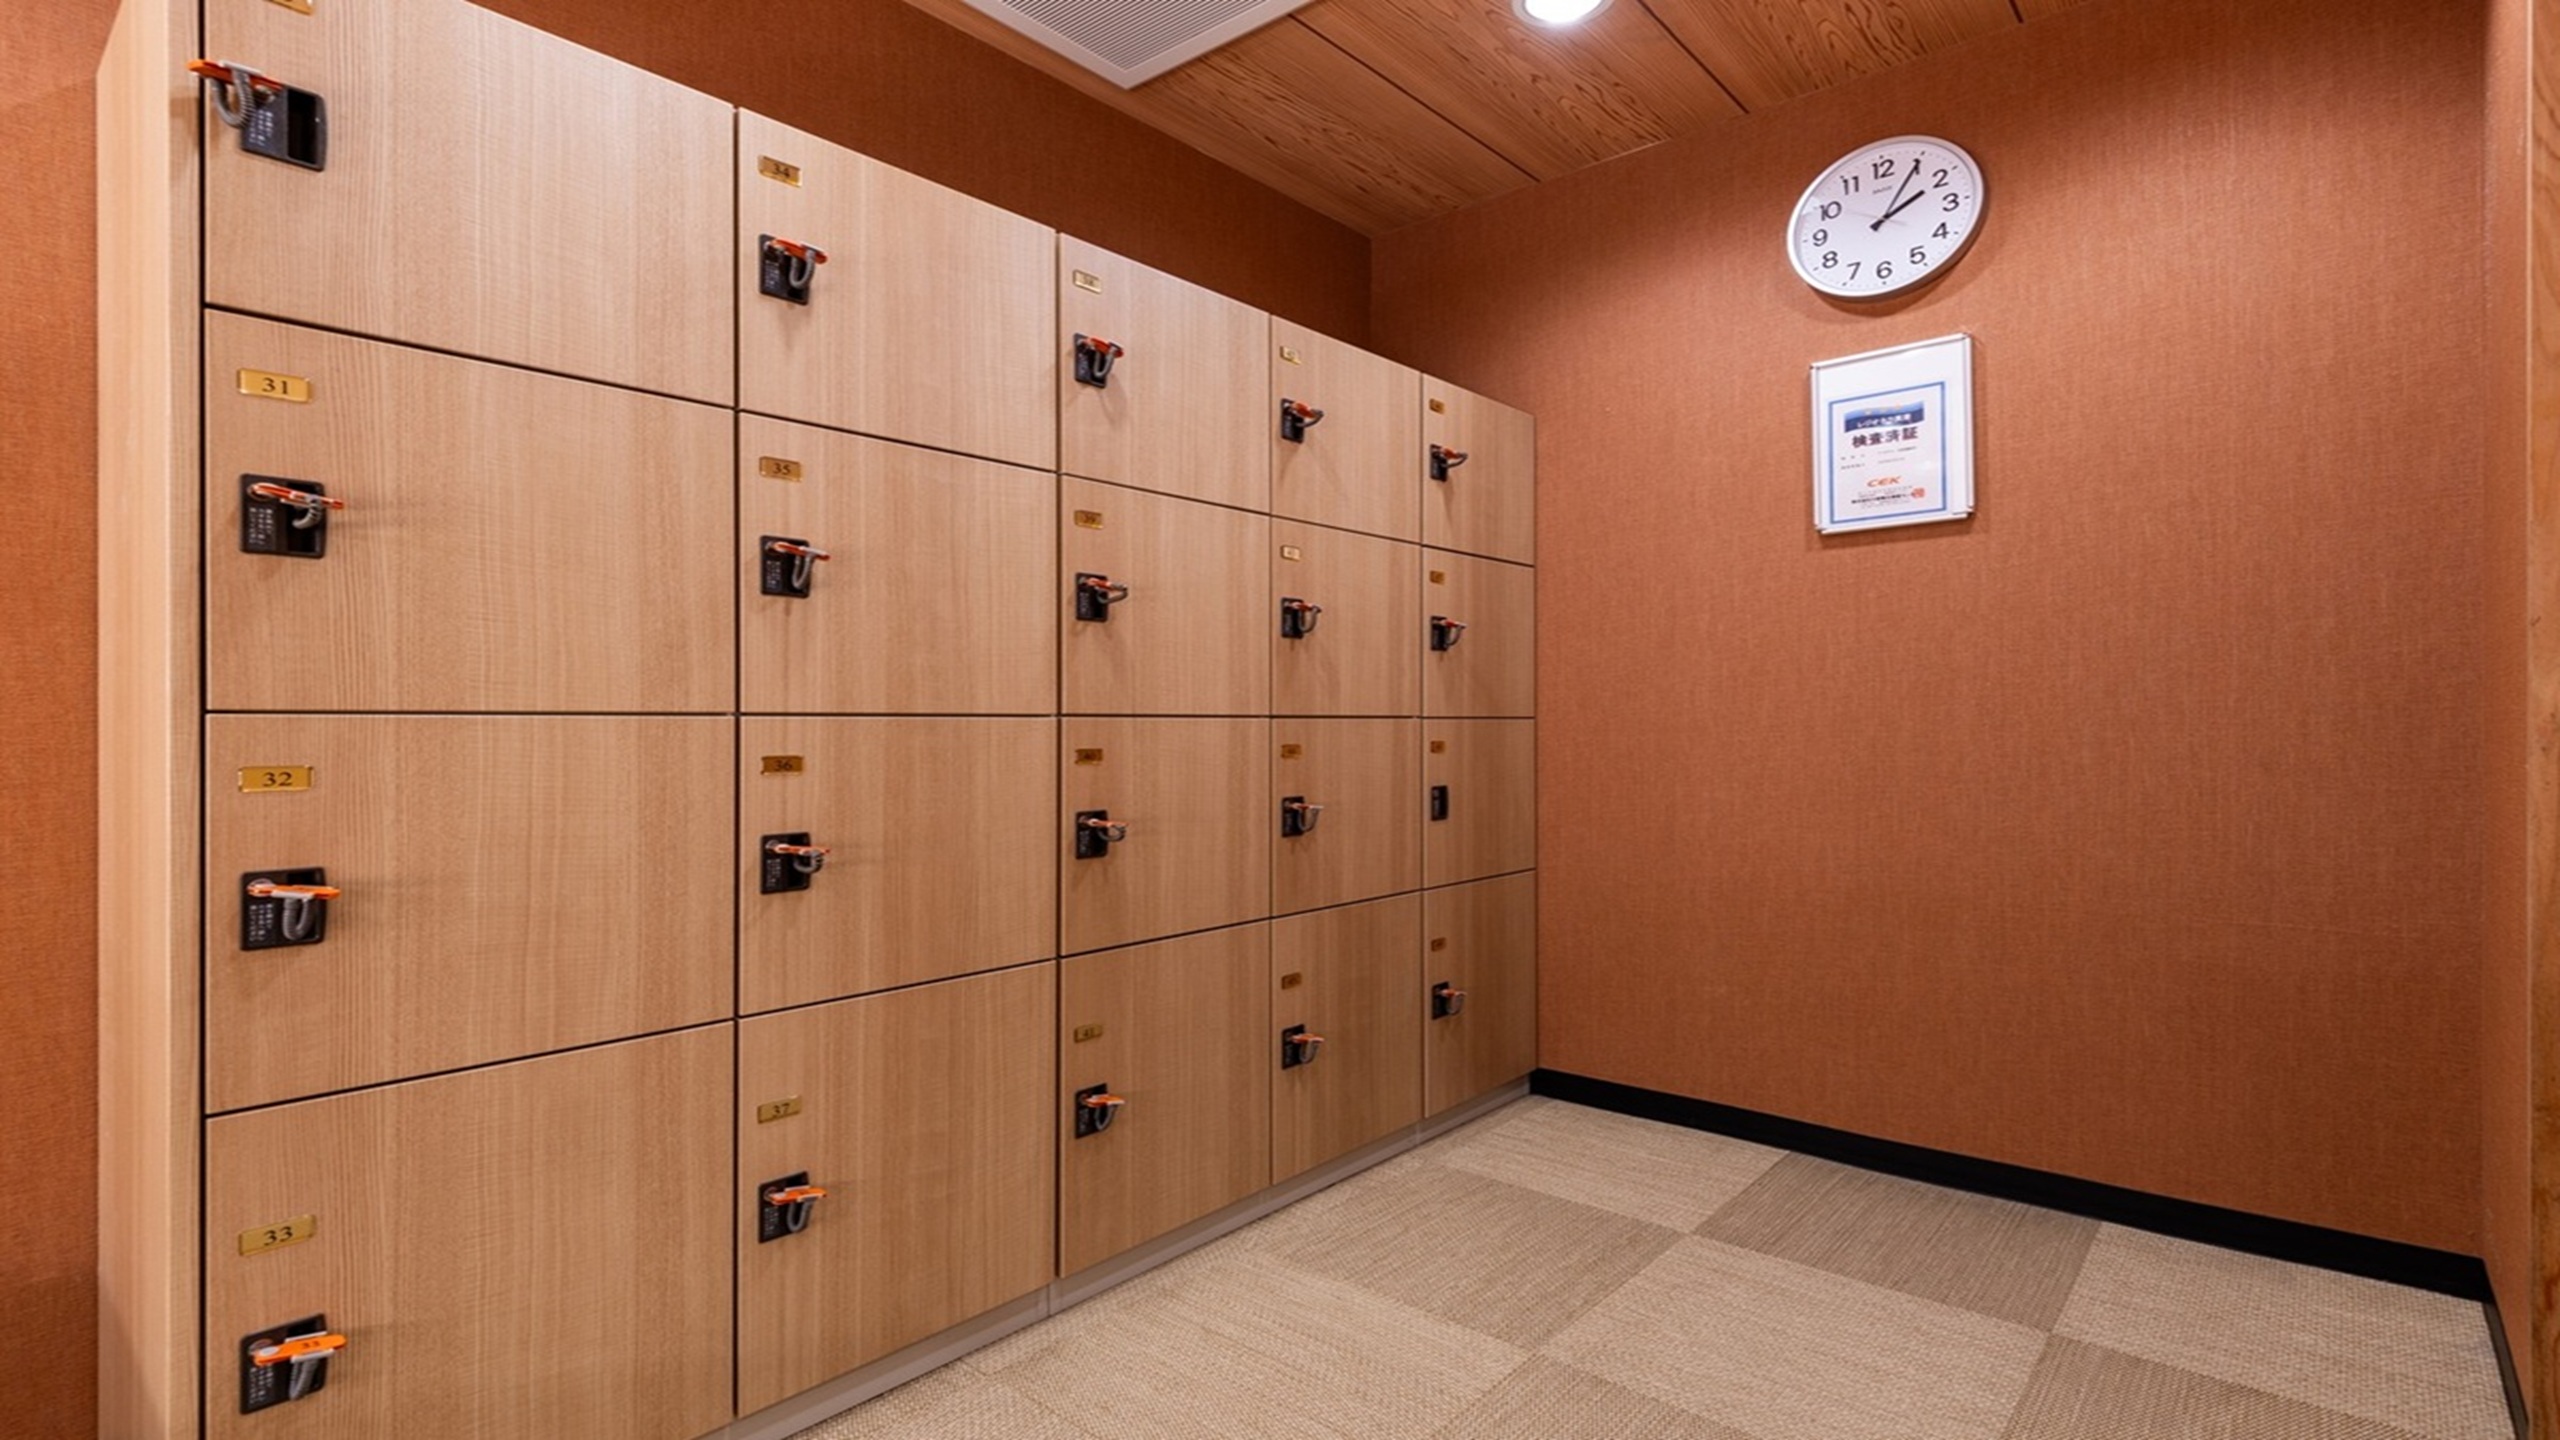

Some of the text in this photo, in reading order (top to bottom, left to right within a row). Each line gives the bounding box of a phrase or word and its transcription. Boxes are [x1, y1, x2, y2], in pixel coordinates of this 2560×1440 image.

[773, 162, 790, 179] 34
[1872, 158, 1895, 179] 12
[1842, 175, 1859, 195] 11
[1932, 168, 1949, 189] 2
[1820, 200, 1842, 221] 10
[1942, 192, 1960, 212] 3
[1812, 229, 1828, 247] 9
[1932, 222, 1949, 239] 4
[1822, 250, 1839, 269] 8
[1910, 246, 1926, 265] 5
[1847, 262, 1861, 280] 7
[1876, 261, 1892, 279] 6
[262, 377, 289, 395] 31
[773, 462, 790, 475] 35
[774, 759, 793, 772] 36
[262, 771, 293, 787] 32
[772, 1102, 790, 1118] 37
[263, 1226, 293, 1246] 33
